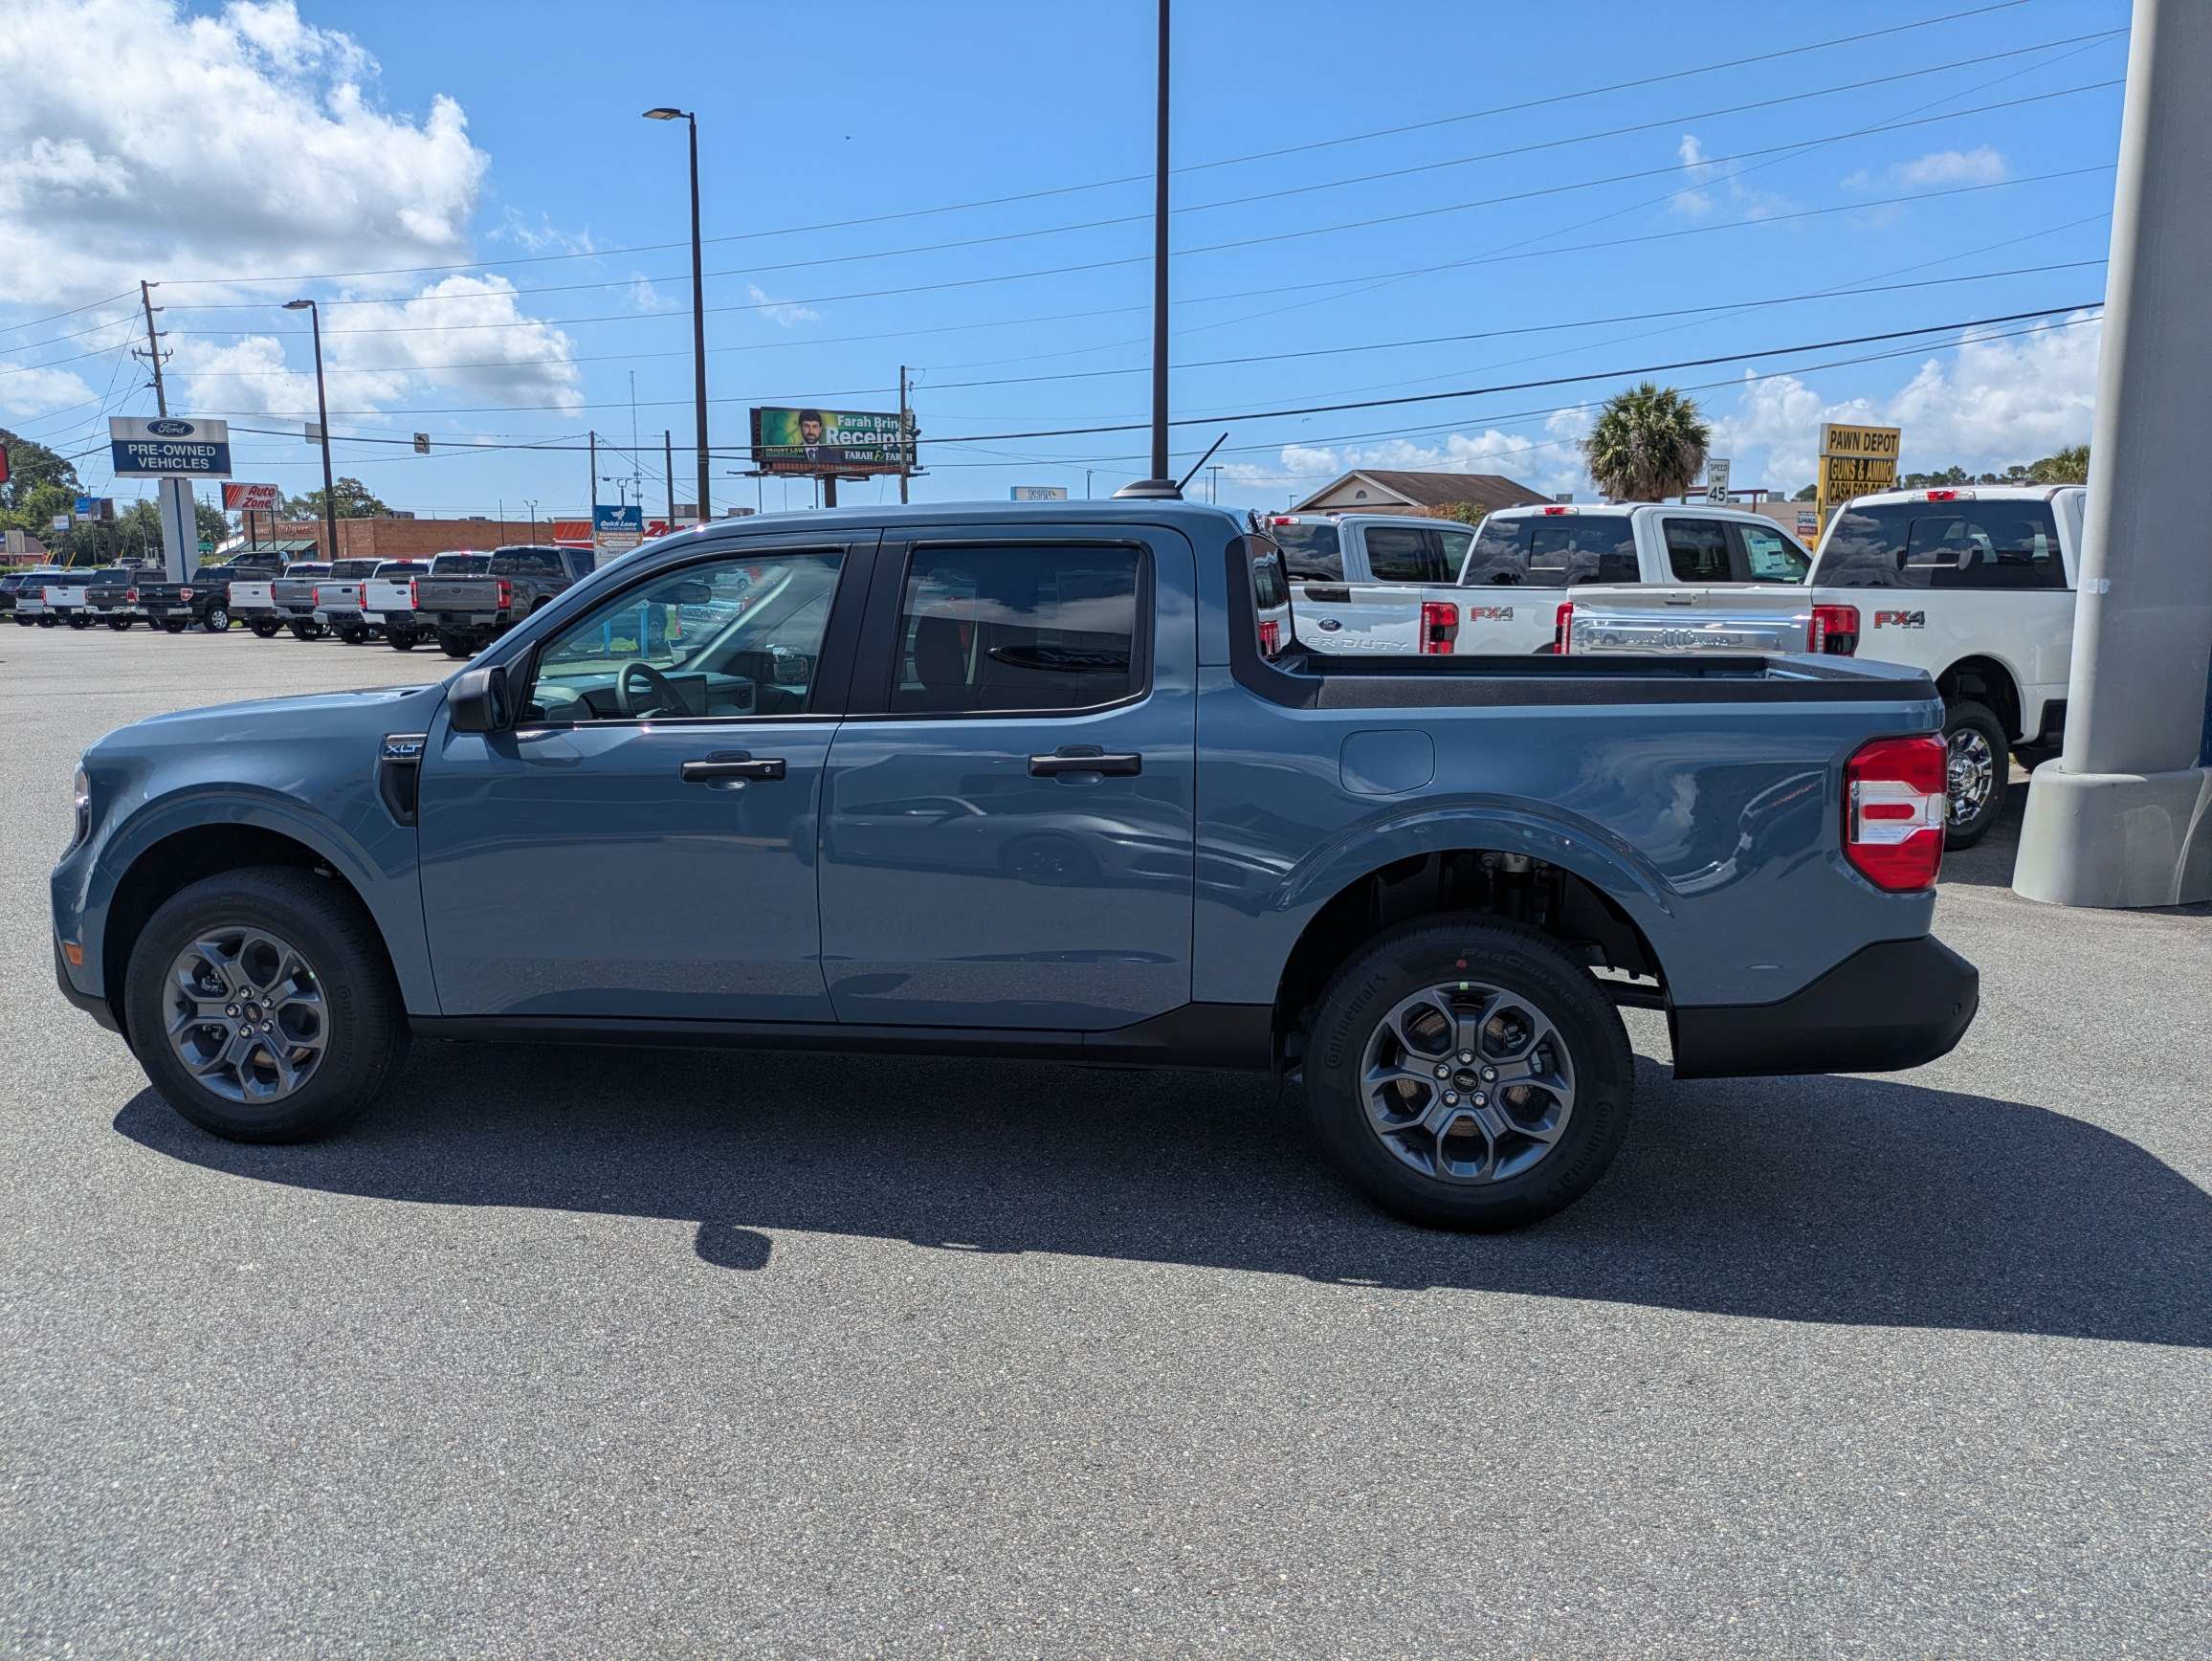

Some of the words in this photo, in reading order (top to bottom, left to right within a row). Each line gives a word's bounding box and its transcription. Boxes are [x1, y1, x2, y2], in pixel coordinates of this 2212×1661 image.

[838, 413, 872, 428] Farah
[874, 416, 912, 431] Brin
[1830, 431, 1860, 451] PAWN
[1864, 432, 1898, 453] DEPOT
[128, 444, 216, 456] PRE-OWNED
[845, 451, 873, 460] FARAH
[886, 452, 913, 461] FARH
[138, 457, 210, 469] VEHICLES
[1831, 458, 1856, 480] GUNS
[1858, 459, 1865, 479] &
[1867, 460, 1892, 482] AMMO
[249, 486, 276, 497] Auto
[1709, 486, 1726, 501] 45
[242, 498, 273, 508] Zone
[1471, 607, 1514, 622] FX4
[1874, 610, 1925, 629] FX4
[1341, 638, 1409, 652] DUTY
[386, 744, 417, 754] XLT
